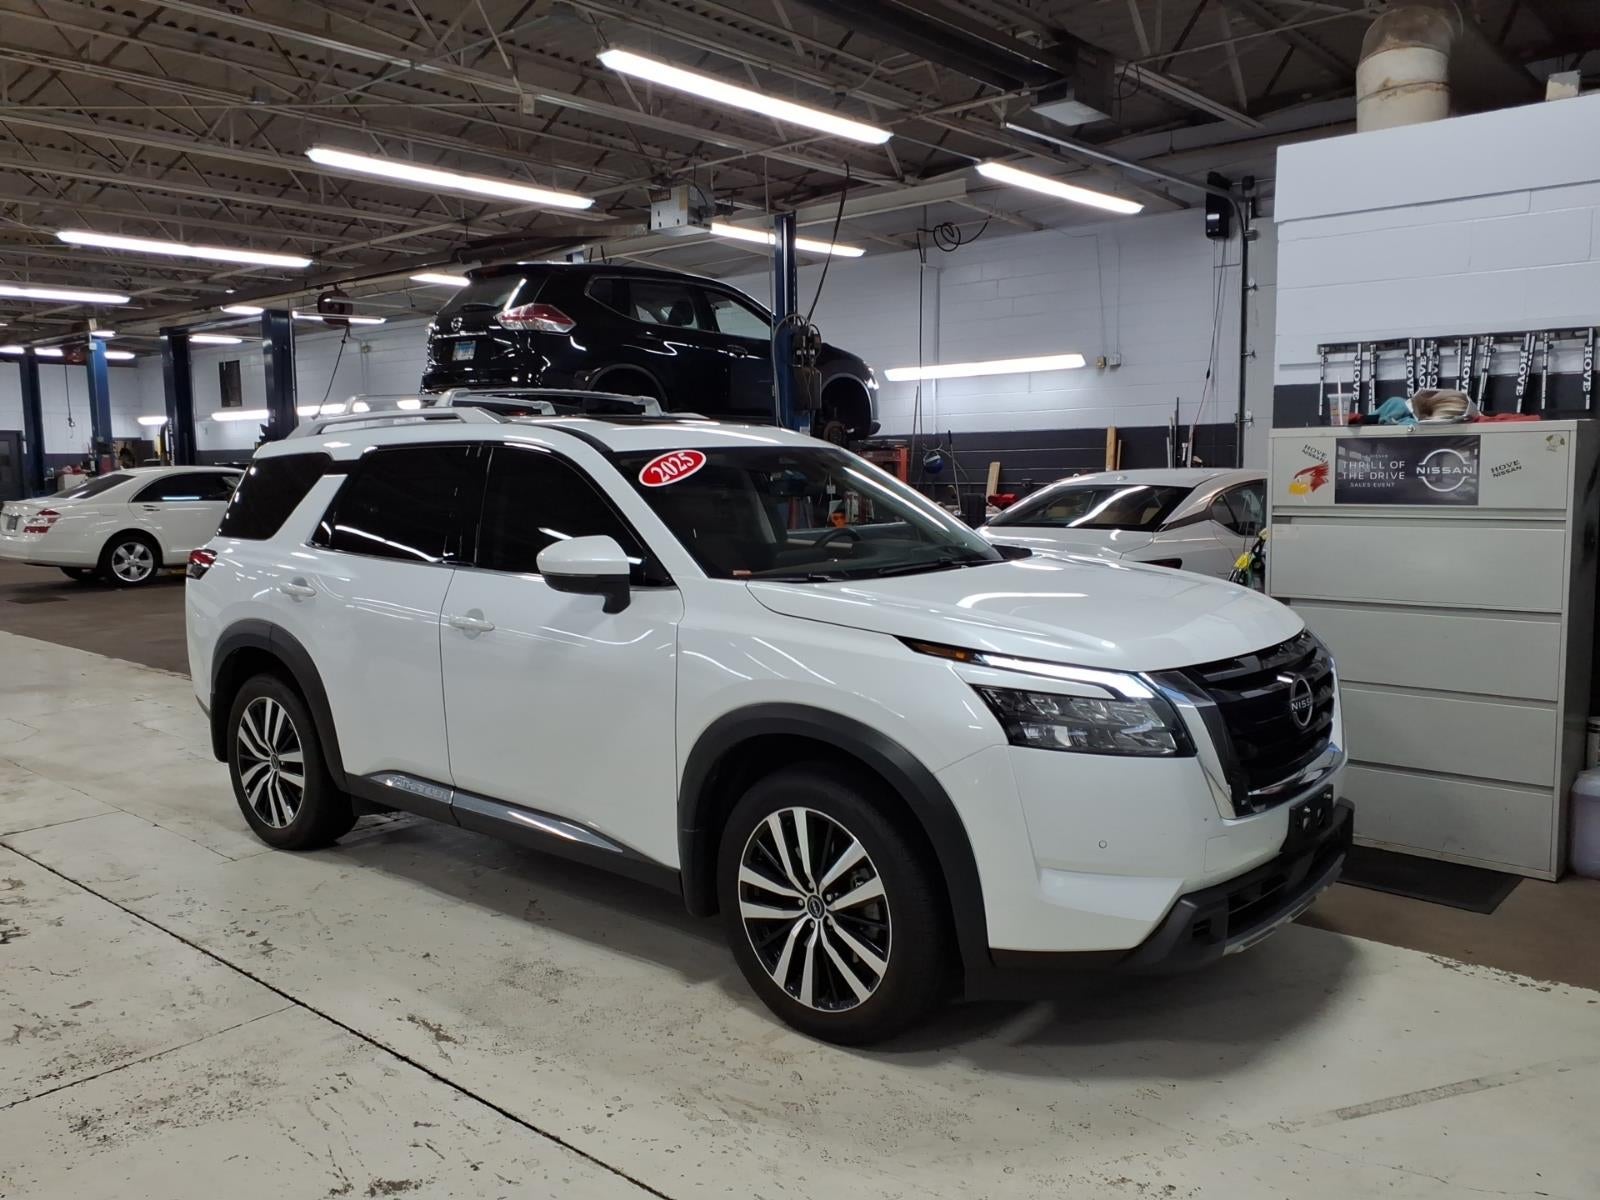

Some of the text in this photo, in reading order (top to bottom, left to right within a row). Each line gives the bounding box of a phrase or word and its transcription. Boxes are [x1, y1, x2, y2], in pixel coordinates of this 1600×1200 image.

[1353, 356, 1361, 400] HOVE
[1406, 355, 1415, 398] HOVE
[1418, 355, 1427, 389] OVE
[1461, 355, 1472, 393] HOV
[1515, 350, 1529, 396] HOVE
[1582, 346, 1593, 392] HOVE
[650, 452, 695, 482] 2025
[1342, 460, 1406, 470] THRILL OF
[1342, 471, 1406, 480] THE DRIVE
[1415, 466, 1474, 475] NISSAN
[1490, 459, 1521, 474] HOVE
[1492, 465, 1523, 478] NISSAN
